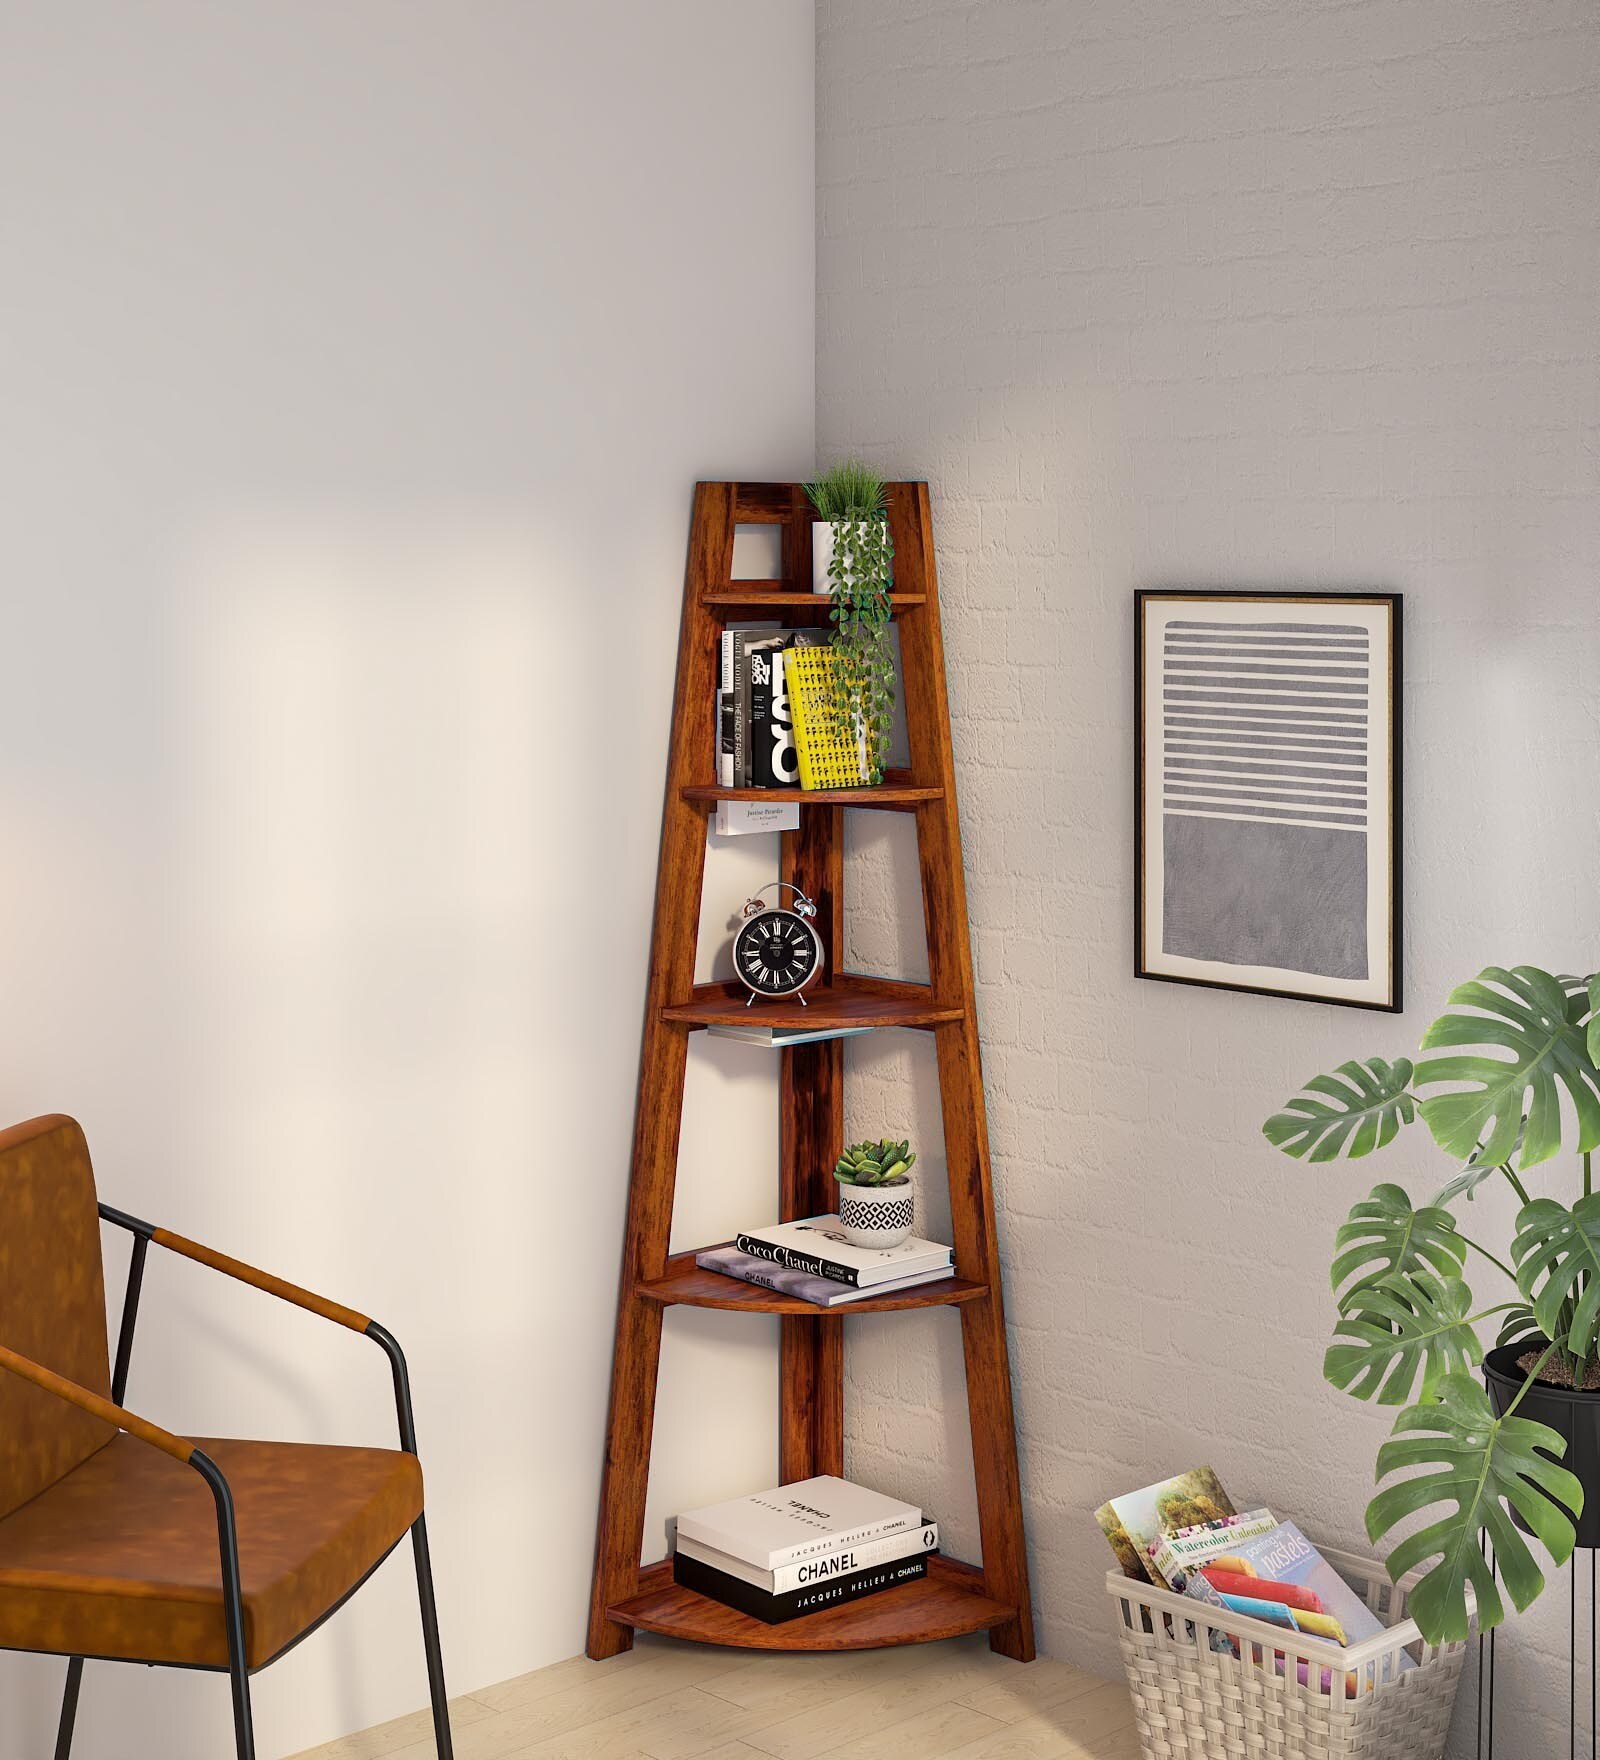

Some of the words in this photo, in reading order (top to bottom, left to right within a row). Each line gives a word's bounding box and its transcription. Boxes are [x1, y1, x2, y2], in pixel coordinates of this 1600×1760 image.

[735, 733, 741, 742] OF
[737, 1236, 772, 1260] Coco
[773, 1247, 824, 1277] Chanel
[744, 1272, 776, 1289] CHANEL
[788, 1500, 830, 1518] CHANEL
[791, 1541, 832, 1558] JACQUES
[840, 1531, 871, 1543] HELLEU
[883, 1520, 907, 1531] CHANEL
[1171, 1534, 1230, 1554] Watercolor
[1229, 1520, 1276, 1541] Unleashed
[1246, 1536, 1279, 1560] painting
[798, 1552, 858, 1583] CHANEL
[1261, 1532, 1310, 1578] pastels
[797, 1587, 842, 1608] JACQUES
[851, 1576, 885, 1592] HELLEU
[897, 1564, 924, 1578] CHANEL
